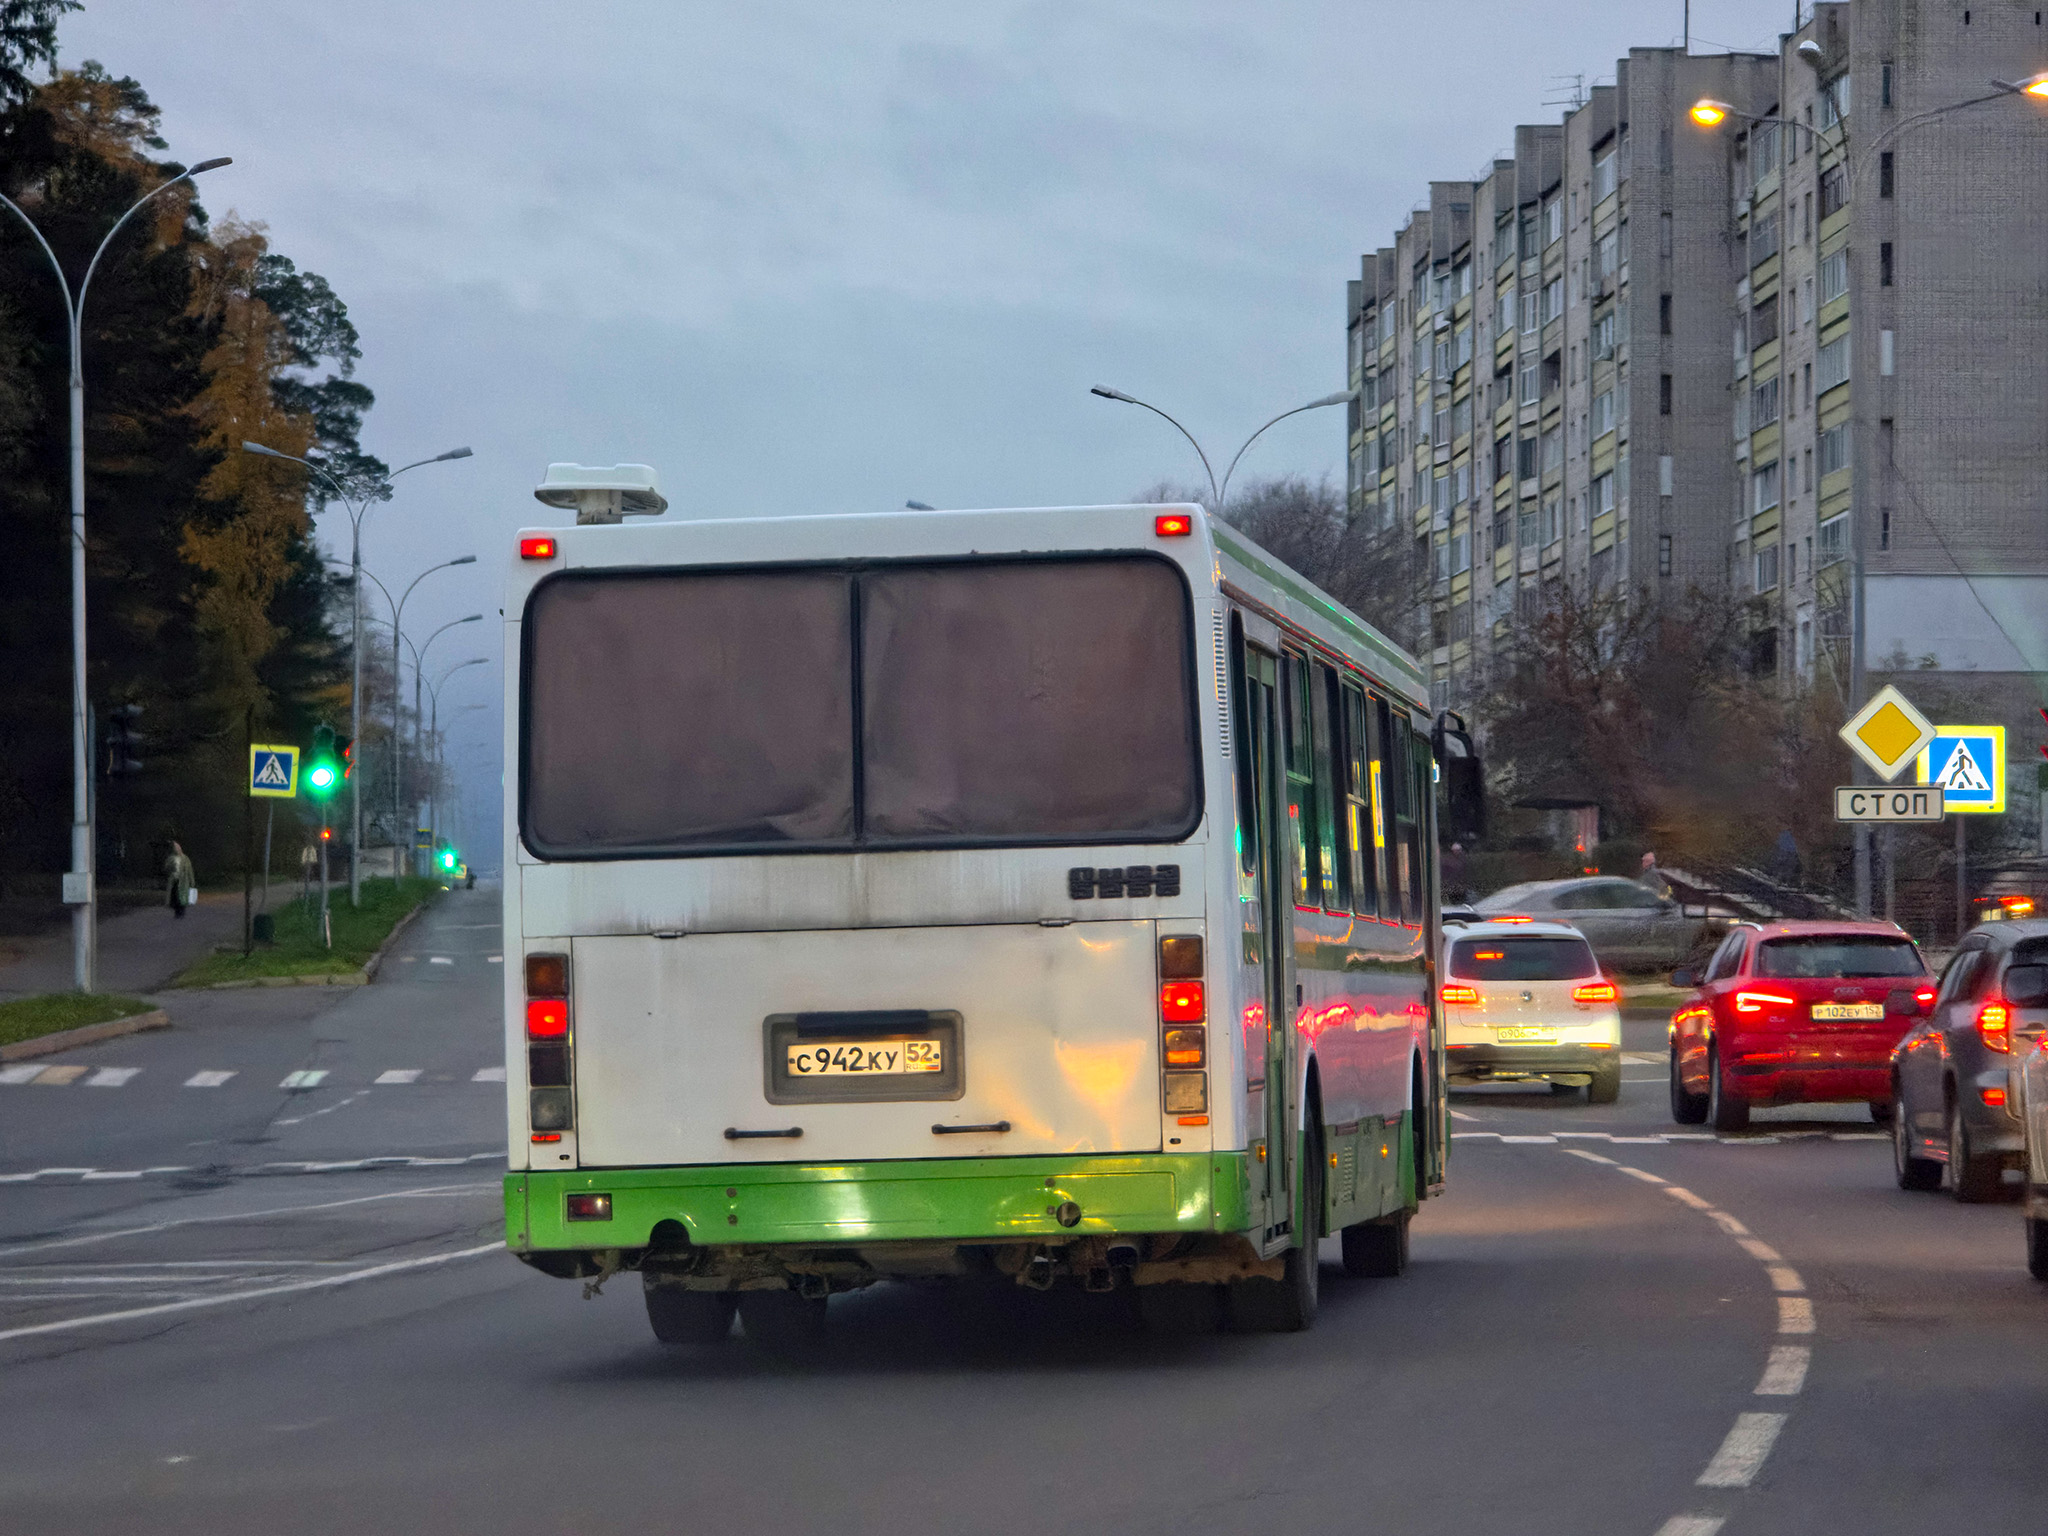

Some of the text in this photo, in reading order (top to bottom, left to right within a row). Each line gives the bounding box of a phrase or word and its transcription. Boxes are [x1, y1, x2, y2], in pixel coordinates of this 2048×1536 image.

[1850, 793, 1928, 816] СТОП
[796, 1042, 933, 1073] С942КУ 52
